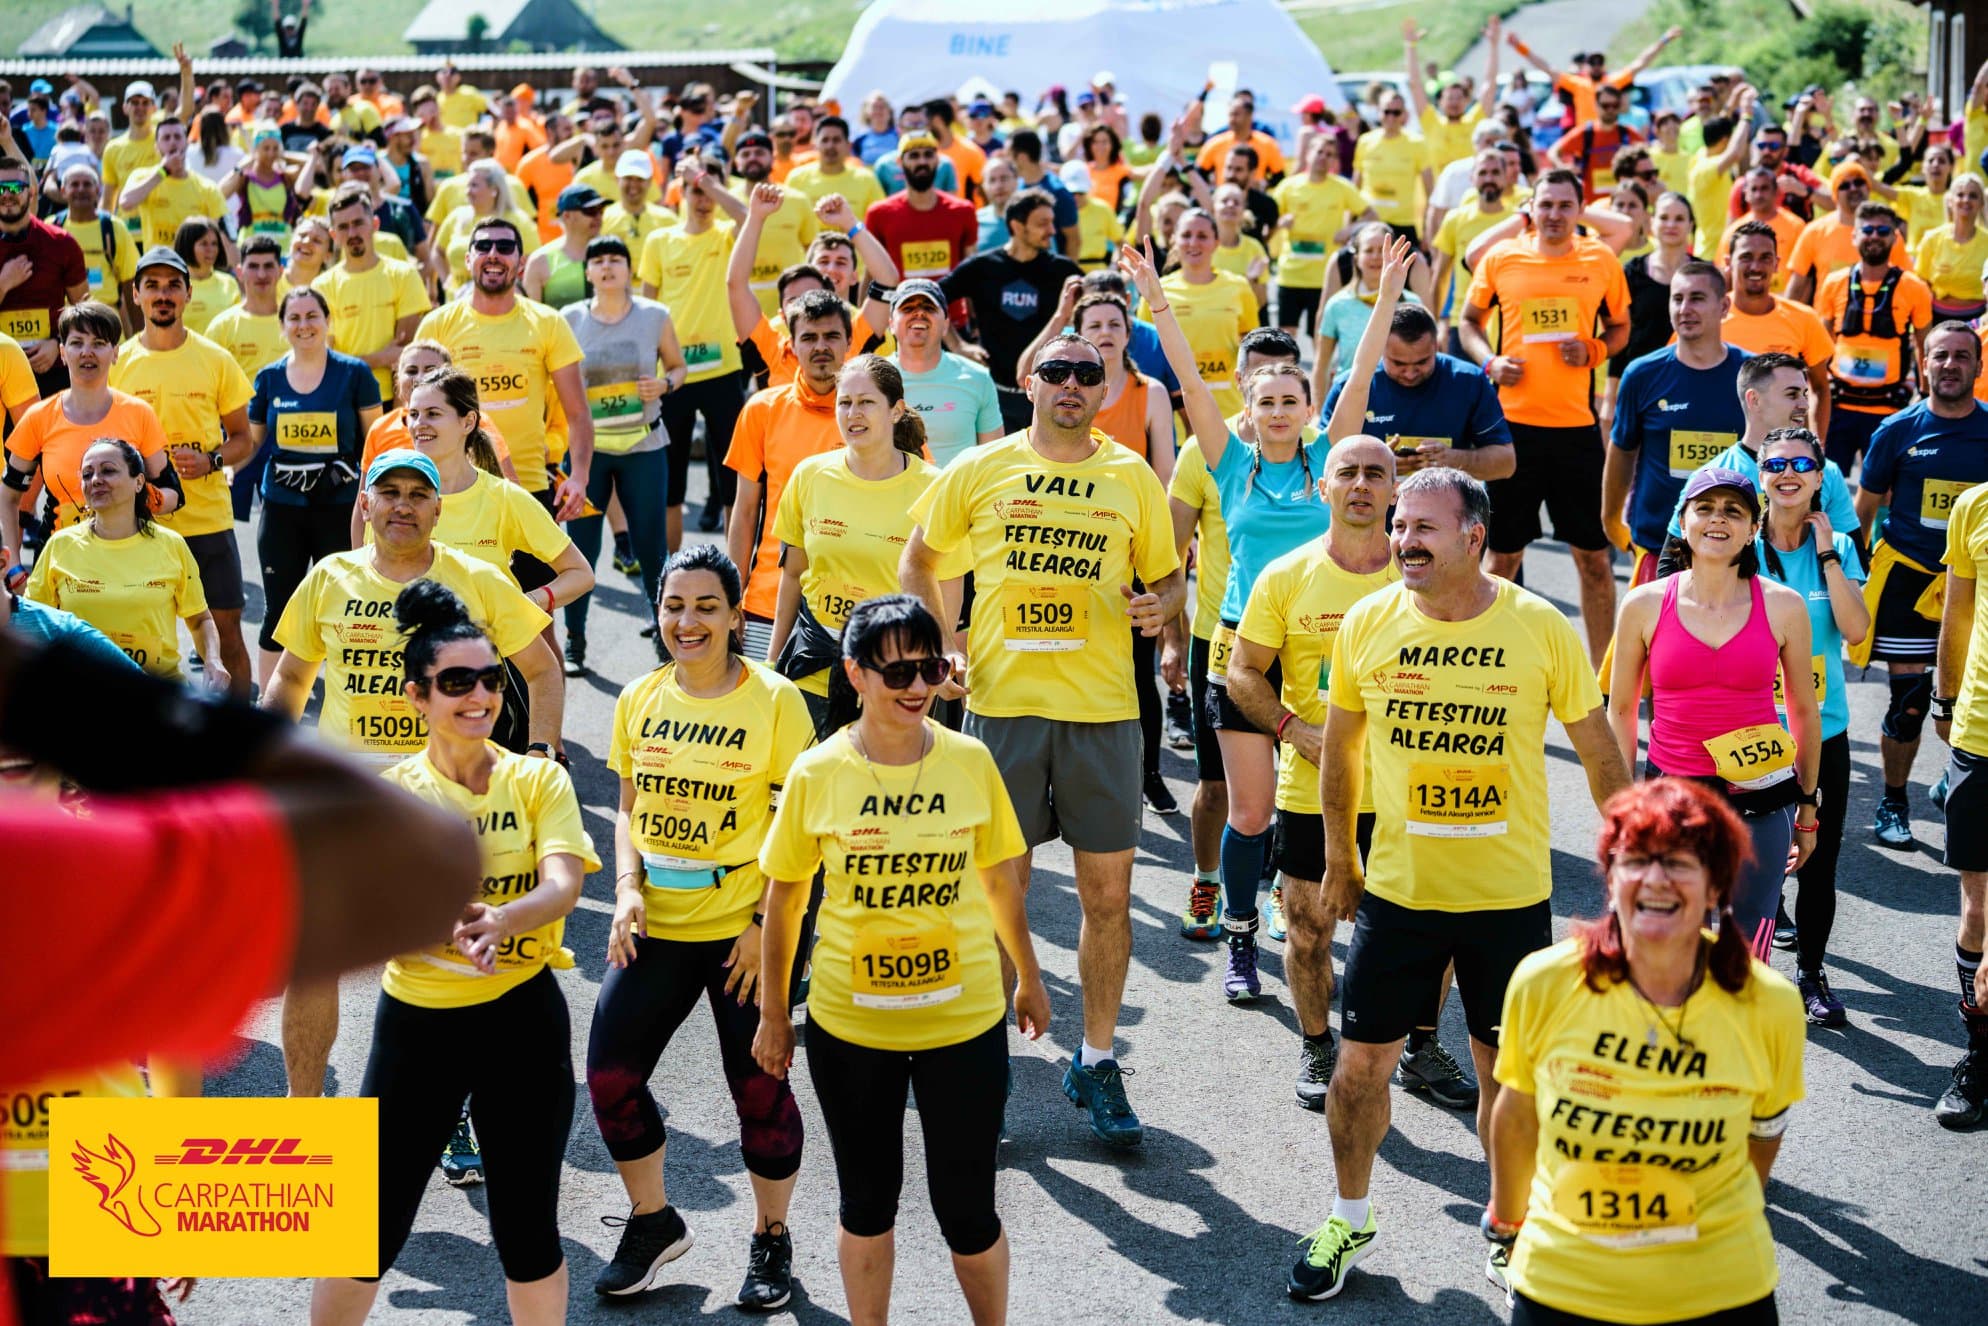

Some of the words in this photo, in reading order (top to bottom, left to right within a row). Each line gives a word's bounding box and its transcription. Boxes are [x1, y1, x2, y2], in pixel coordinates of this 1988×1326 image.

[948, 32, 1013, 57] BINE
[906, 250, 947, 265] 1512D
[1001, 291, 1038, 307] RUN
[8, 319, 41, 334] 1501
[1531, 309, 1568, 325] 1531
[1196, 361, 1227, 375] 24A
[600, 394, 628, 411] 525
[282, 424, 332, 438] 1362A
[1677, 443, 1730, 461] 1539
[1025, 473, 1096, 499] VALI
[1004, 524, 1108, 553] FETEȘTIUL
[344, 599, 396, 619] FLOR
[1016, 603, 1073, 625] 1509
[342, 648, 405, 670] FETEȘ
[1399, 646, 1506, 668] MARCEL
[1485, 684, 1518, 693] MPG
[1385, 698, 1508, 727] FETEȘTIUL
[356, 715, 430, 738] 1509D
[640, 717, 748, 751] LAVINIA
[1390, 727, 1506, 757] ALEARGĂ
[1729, 739, 1785, 769] 1554
[720, 760, 752, 772] MPG
[859, 793, 946, 816] ANCA
[1417, 784, 1502, 809] 1314A
[467, 811, 519, 836] VIA
[639, 812, 709, 845] 1509A
[480, 872, 541, 899] ȘTIU
[862, 948, 951, 979] 1509B
[1593, 1032, 1709, 1079] ELENA
[1551, 1098, 1728, 1147] FETEȘTIUL
[1578, 1190, 1670, 1221] 1314
